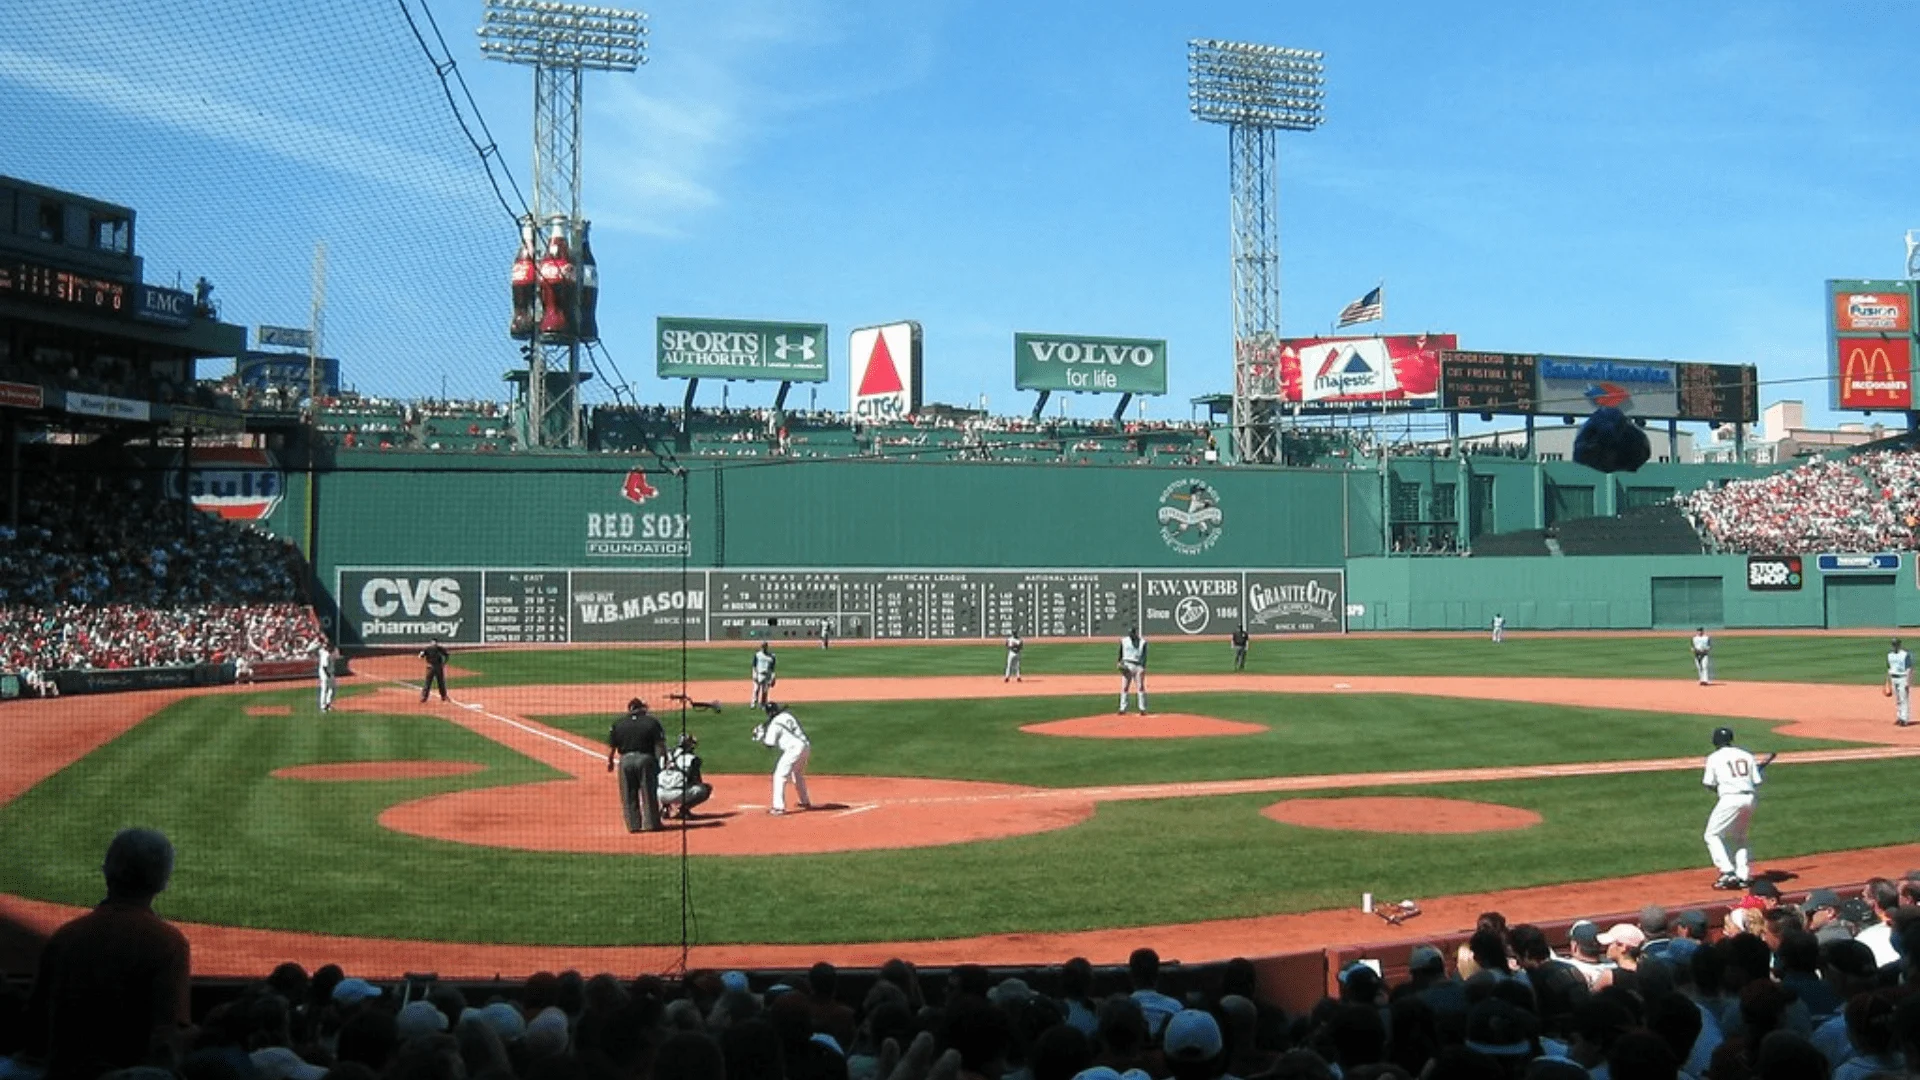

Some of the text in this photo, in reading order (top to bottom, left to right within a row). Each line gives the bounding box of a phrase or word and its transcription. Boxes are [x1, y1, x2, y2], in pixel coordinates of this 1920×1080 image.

[146, 290, 185, 314] EMC
[1849, 304, 1897, 317] Fusion
[662, 330, 759, 354] SPORTS
[1027, 341, 1154, 367] VOLVO
[1066, 368, 1118, 388] for life
[857, 395, 904, 419] CITGO
[588, 512, 691, 538] RED SOX
[590, 544, 688, 553] FOUNDATION
[1750, 562, 1786, 574] STOP
[1147, 580, 1238, 596] F.W. WEBB
[1751, 573, 1788, 585] SHOP
[361, 577, 461, 617] CVS
[597, 592, 614, 602] BUT
[1249, 580, 1337, 612] GRANITE CITY
[731, 602, 757, 610] BOSTON
[1147, 608, 1170, 619] Since
[362, 619, 461, 637] pharmacy
[1727, 758, 1748, 778] 10
